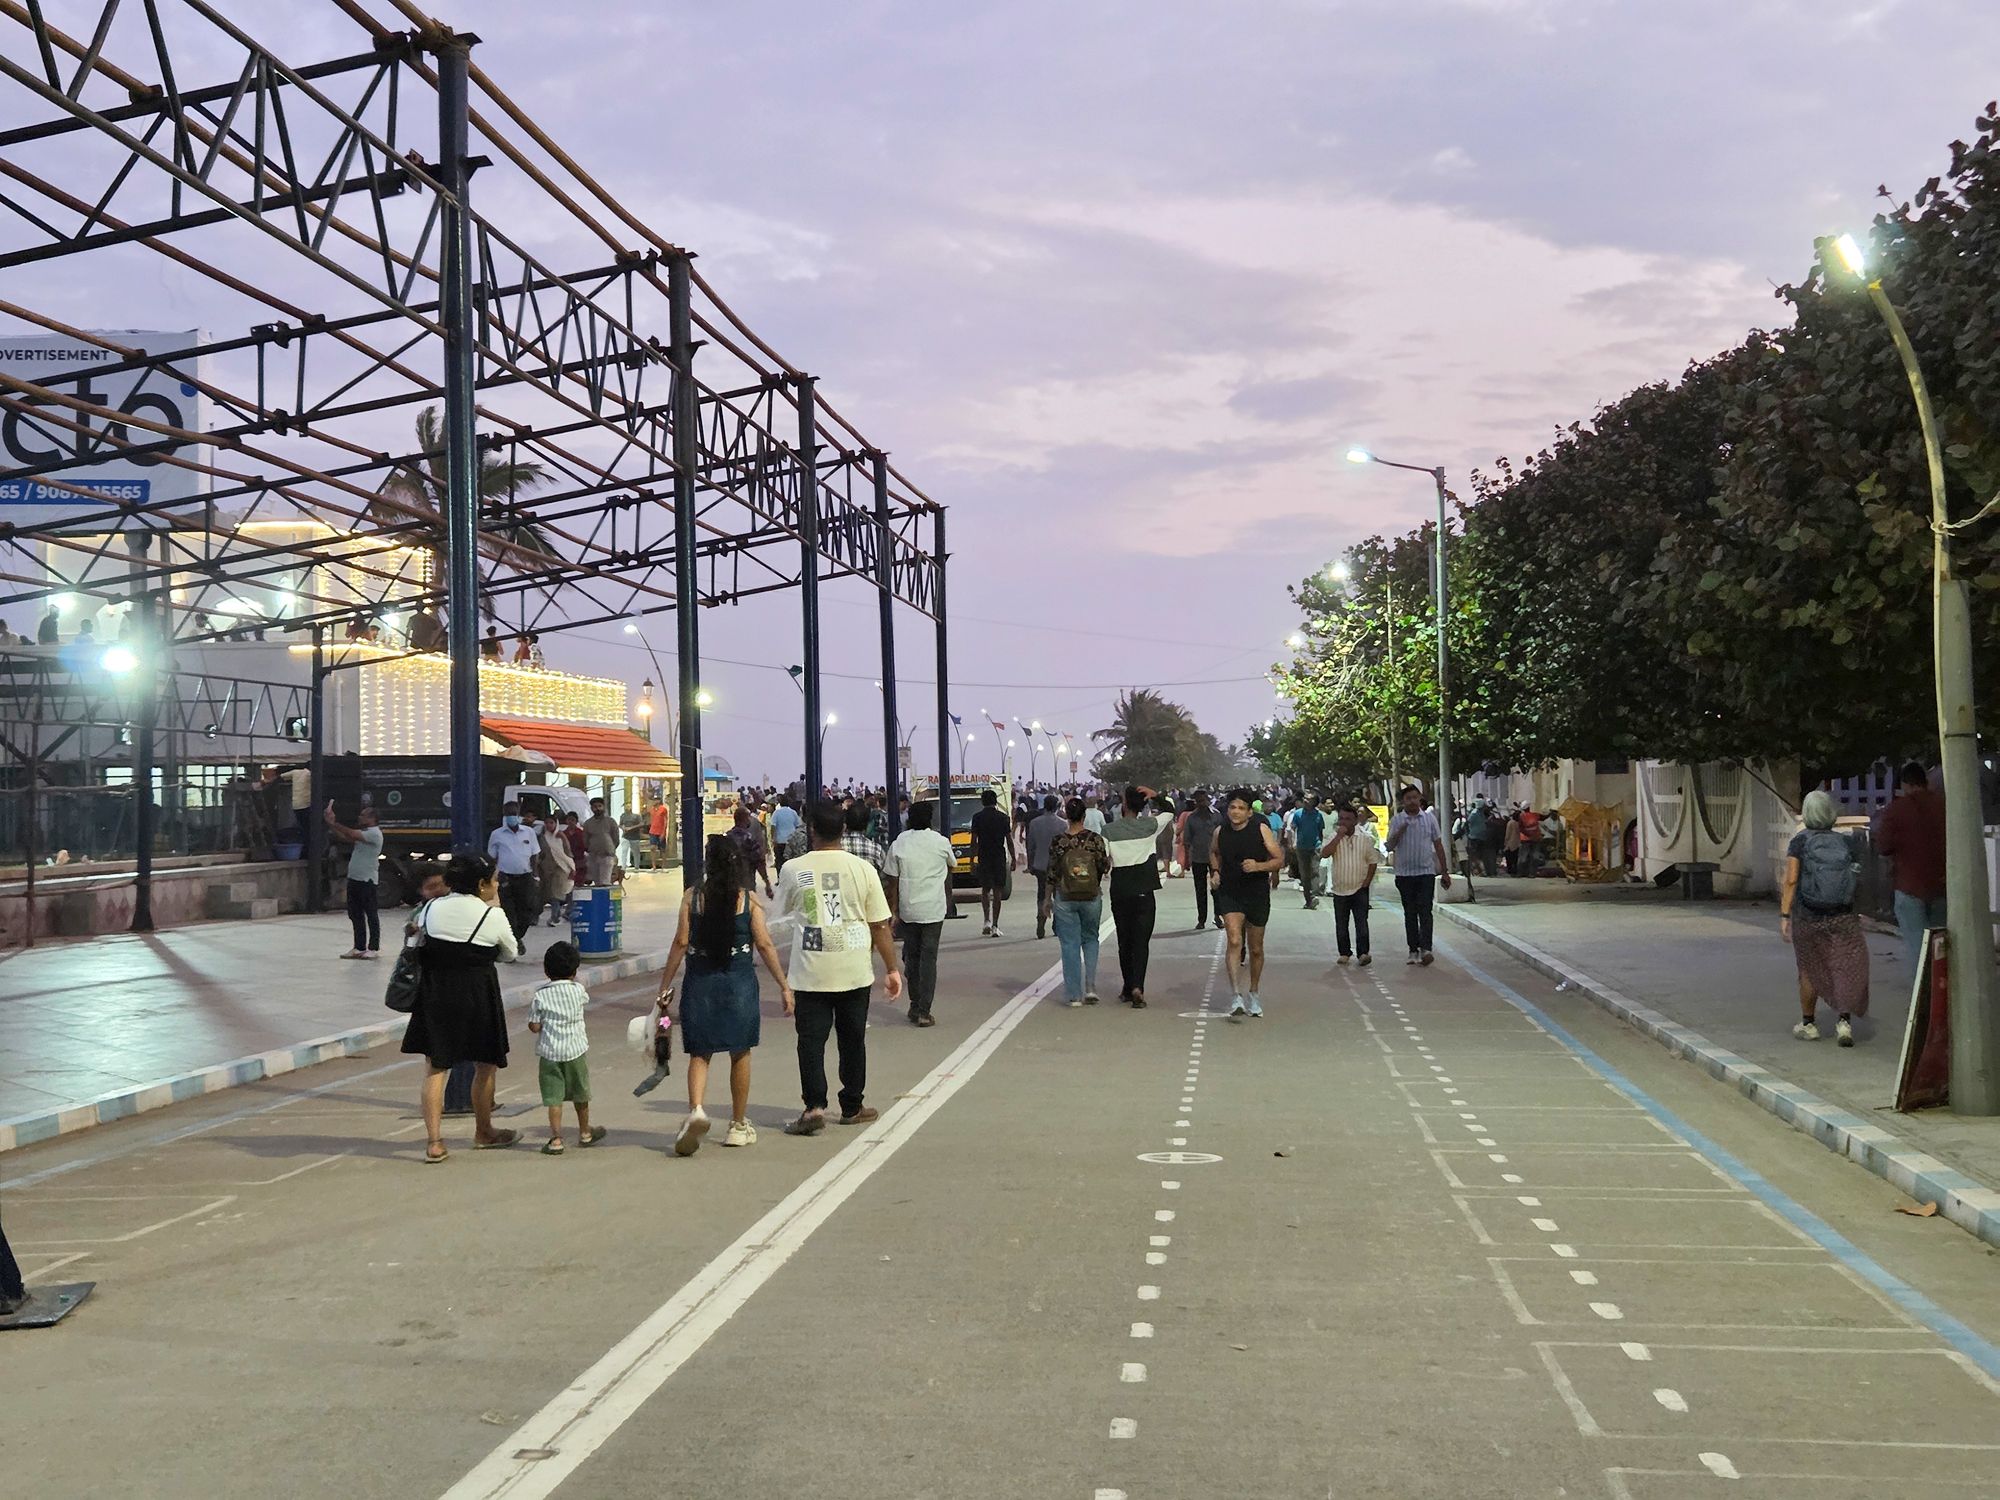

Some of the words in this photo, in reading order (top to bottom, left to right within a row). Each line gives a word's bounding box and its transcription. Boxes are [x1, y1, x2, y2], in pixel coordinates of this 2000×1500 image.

[0, 485, 20, 499] 65
[36, 485, 142, 500] 90815565
[928, 774, 978, 784] RAAPILLAI
